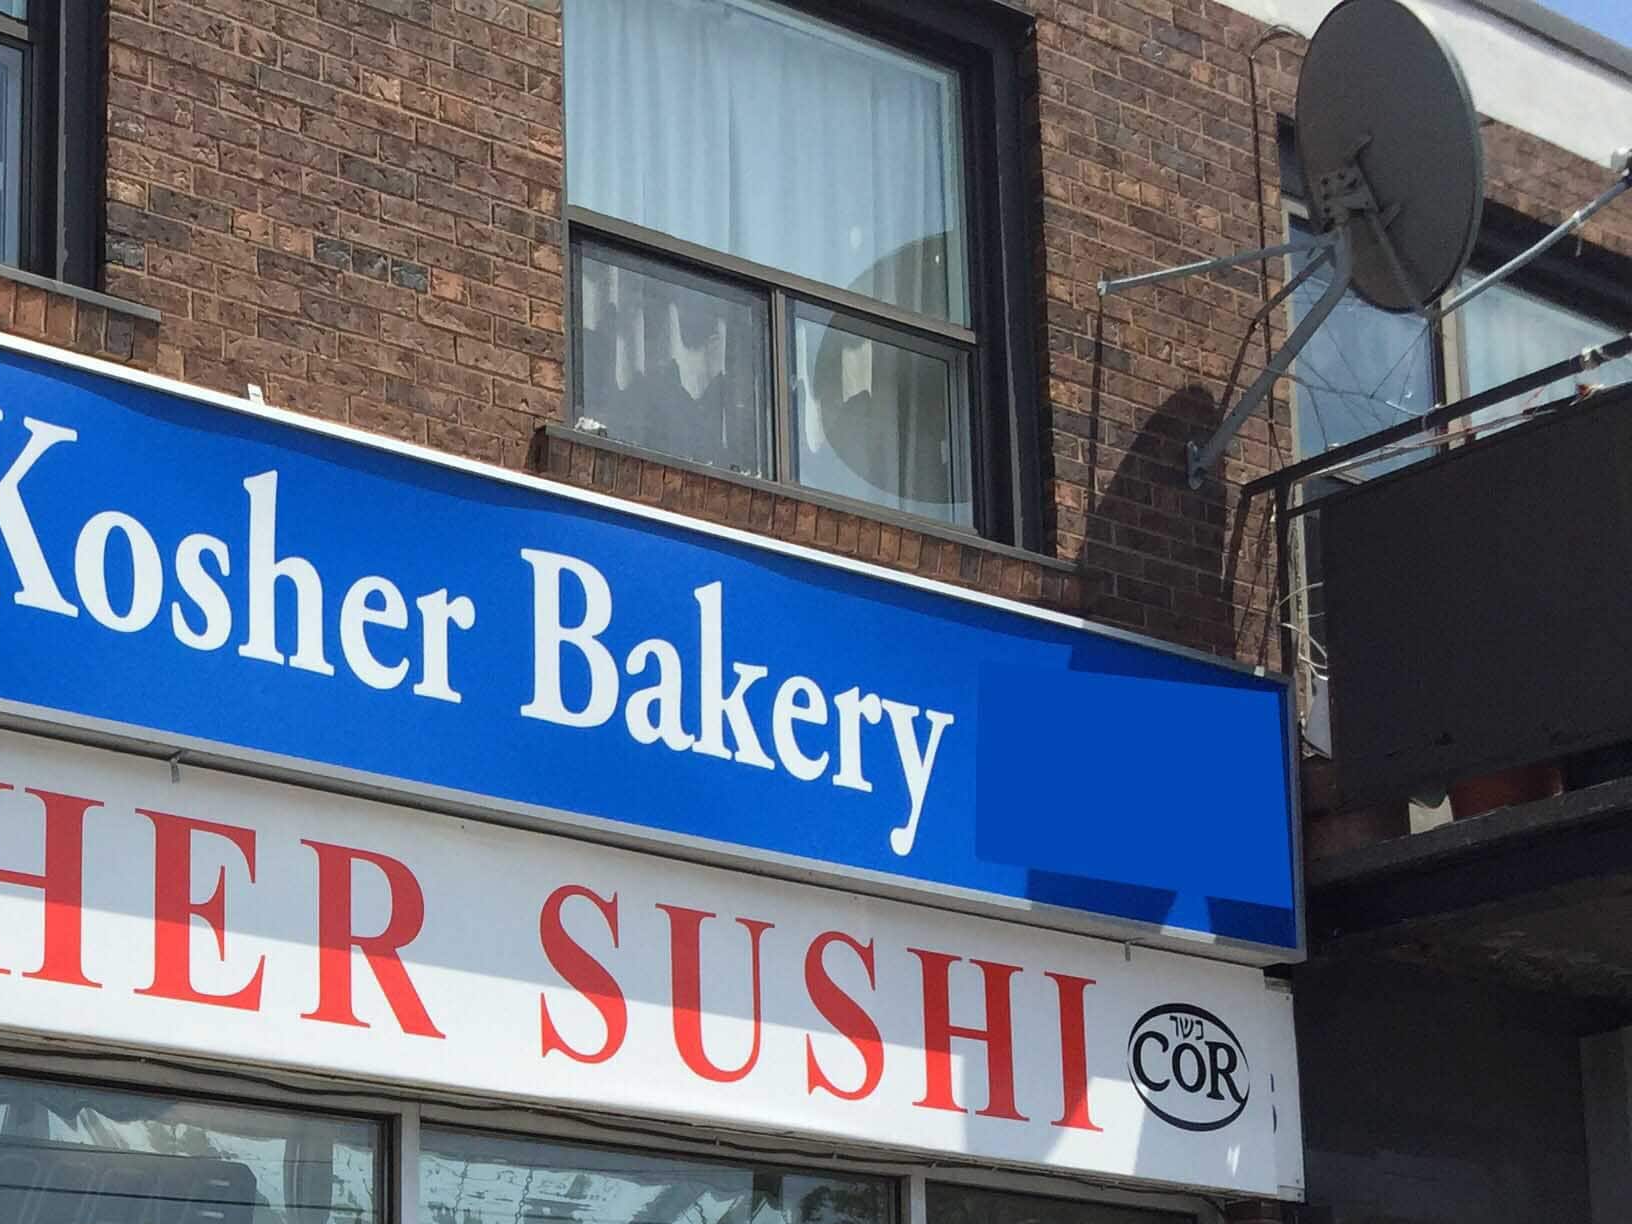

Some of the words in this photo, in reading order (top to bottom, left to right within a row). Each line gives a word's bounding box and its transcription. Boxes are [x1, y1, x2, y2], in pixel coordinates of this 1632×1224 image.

[521, 548, 954, 856] Bakery
[540, 885, 1105, 1131] SUSHI
[1132, 1030, 1245, 1104] COR
